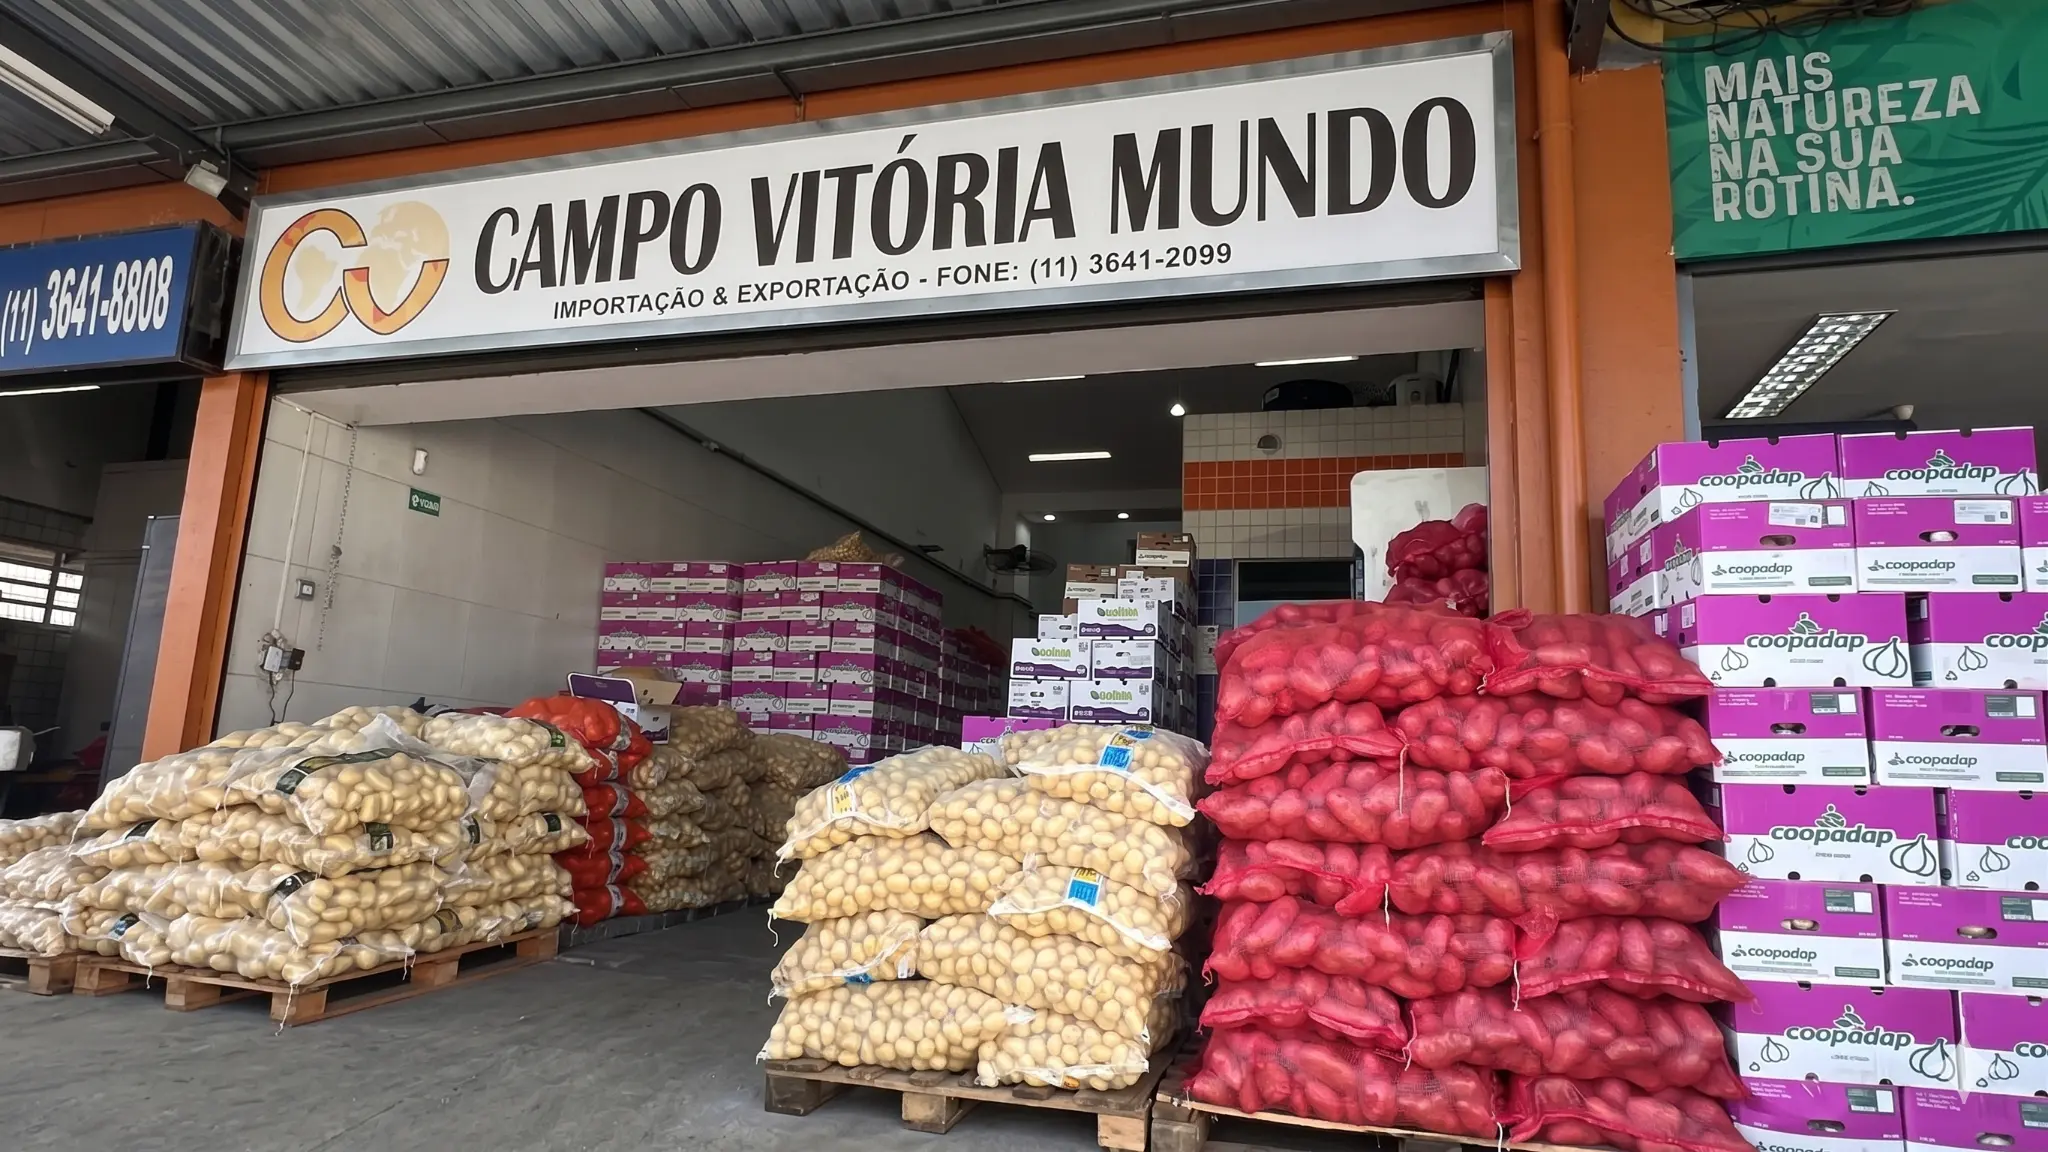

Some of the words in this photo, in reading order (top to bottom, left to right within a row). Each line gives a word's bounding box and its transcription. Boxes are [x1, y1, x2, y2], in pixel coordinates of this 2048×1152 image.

[1705, 52, 1832, 103] MAIS
[1708, 75, 1980, 142] NATUREZA
[1710, 138, 1779, 182] NA
[1796, 125, 1902, 174] SUA
[475, 183, 721, 294] CAMPO
[751, 134, 1077, 267] VITÓRIA
[1111, 97, 1476, 234] MUNDO
[1712, 167, 1915, 222] ROTINA.
[553, 286, 704, 319] IMPORTAÇÃO
[713, 287, 728, 305] &
[738, 270, 909, 304] EXPORTAÇÃO
[937, 261, 1018, 287] FONE:
[1030, 256, 1077, 285] (11)
[1090, 243, 1232, 275] 3641-2099
[1, 287, 37, 357] (11)
[41, 255, 173, 340] 3641-8808
[1700, 470, 1801, 489] coopadap
[1886, 464, 1997, 483] coopadap
[1728, 563, 1793, 575] coopadap
[1885, 559, 1956, 571] coopadap
[1746, 631, 1865, 652] coopadap
[1739, 751, 1805, 763] coopadap
[1906, 754, 1977, 767] coopadap
[1771, 825, 1893, 847] coopadap
[1920, 957, 1994, 972] coopadap
[1786, 1027, 1912, 1051] coopadap
